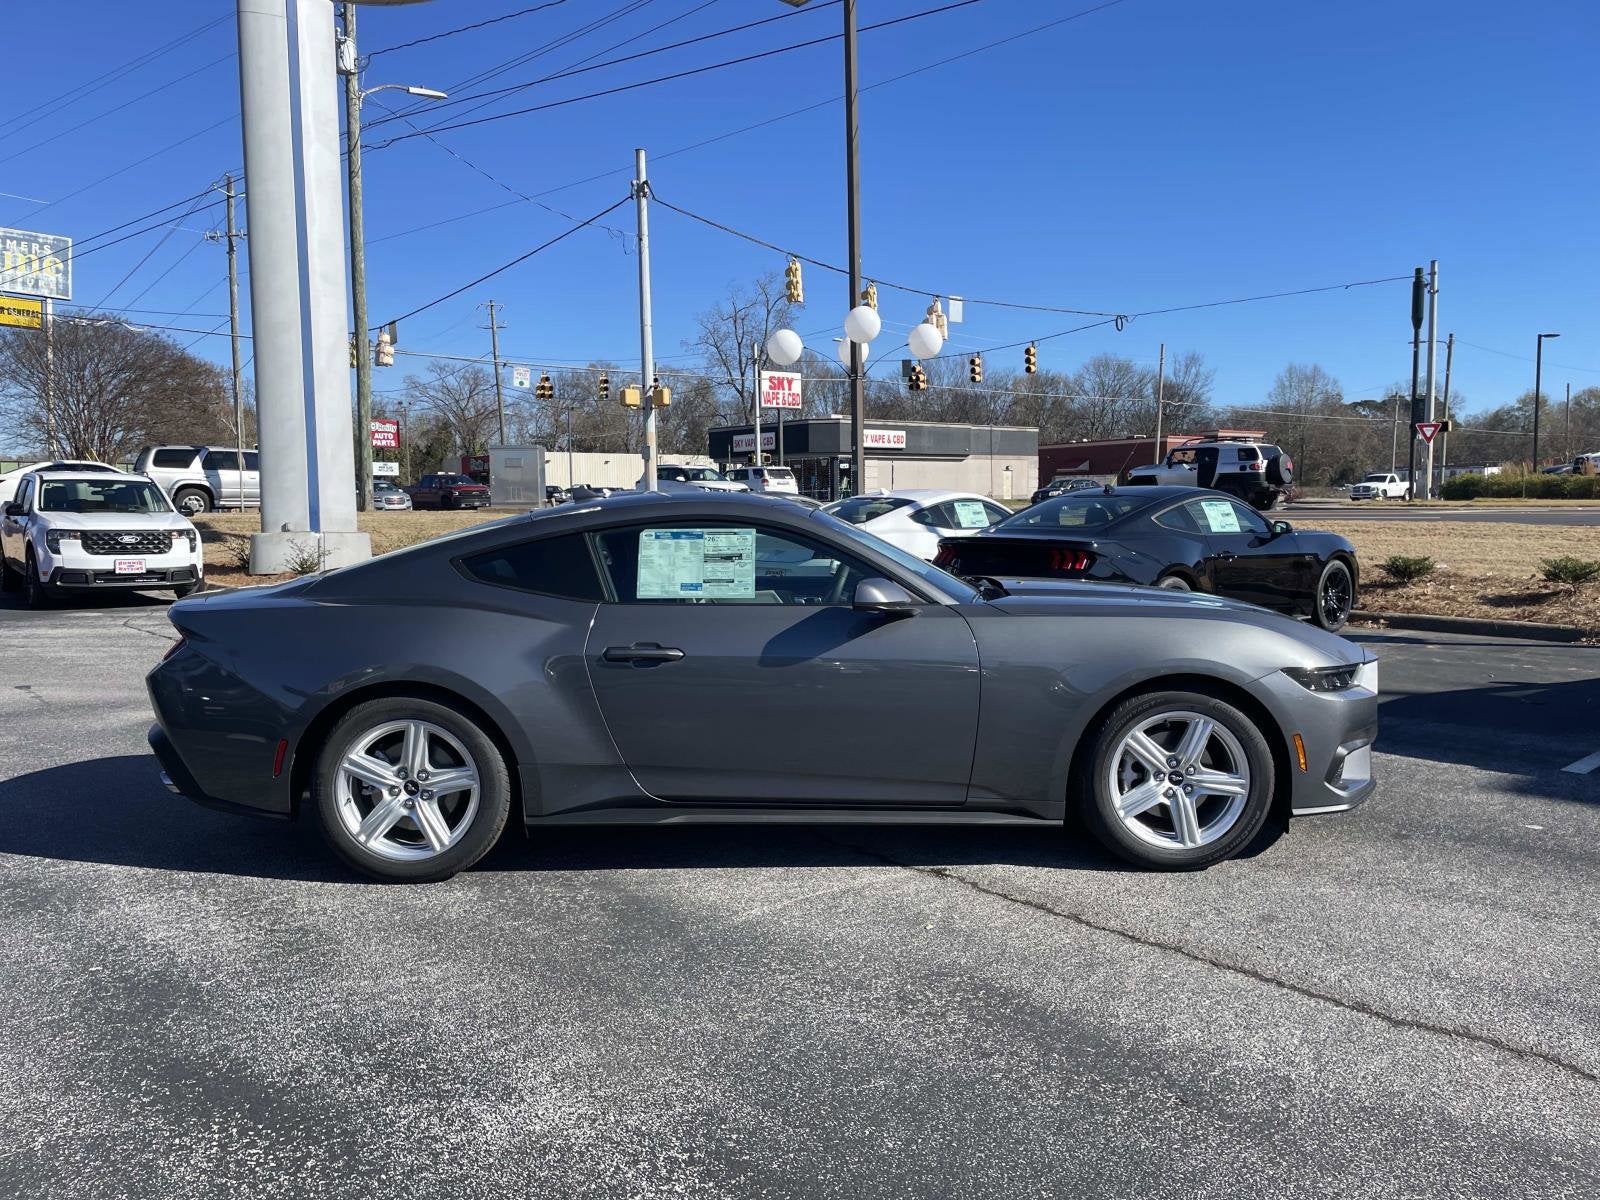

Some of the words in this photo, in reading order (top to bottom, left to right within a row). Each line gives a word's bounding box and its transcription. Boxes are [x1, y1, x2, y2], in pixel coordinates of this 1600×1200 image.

[768, 375, 794, 391] SKY
[763, 391, 780, 405] VAPE
[782, 392, 787, 406] &
[787, 392, 801, 407] CBD
[372, 439, 396, 447] PARTS
[735, 438, 744, 449] SKY
[763, 436, 774, 446] CBD
[870, 434, 885, 444] VAPE
[887, 435, 891, 444] &
[893, 435, 905, 444] CBD
